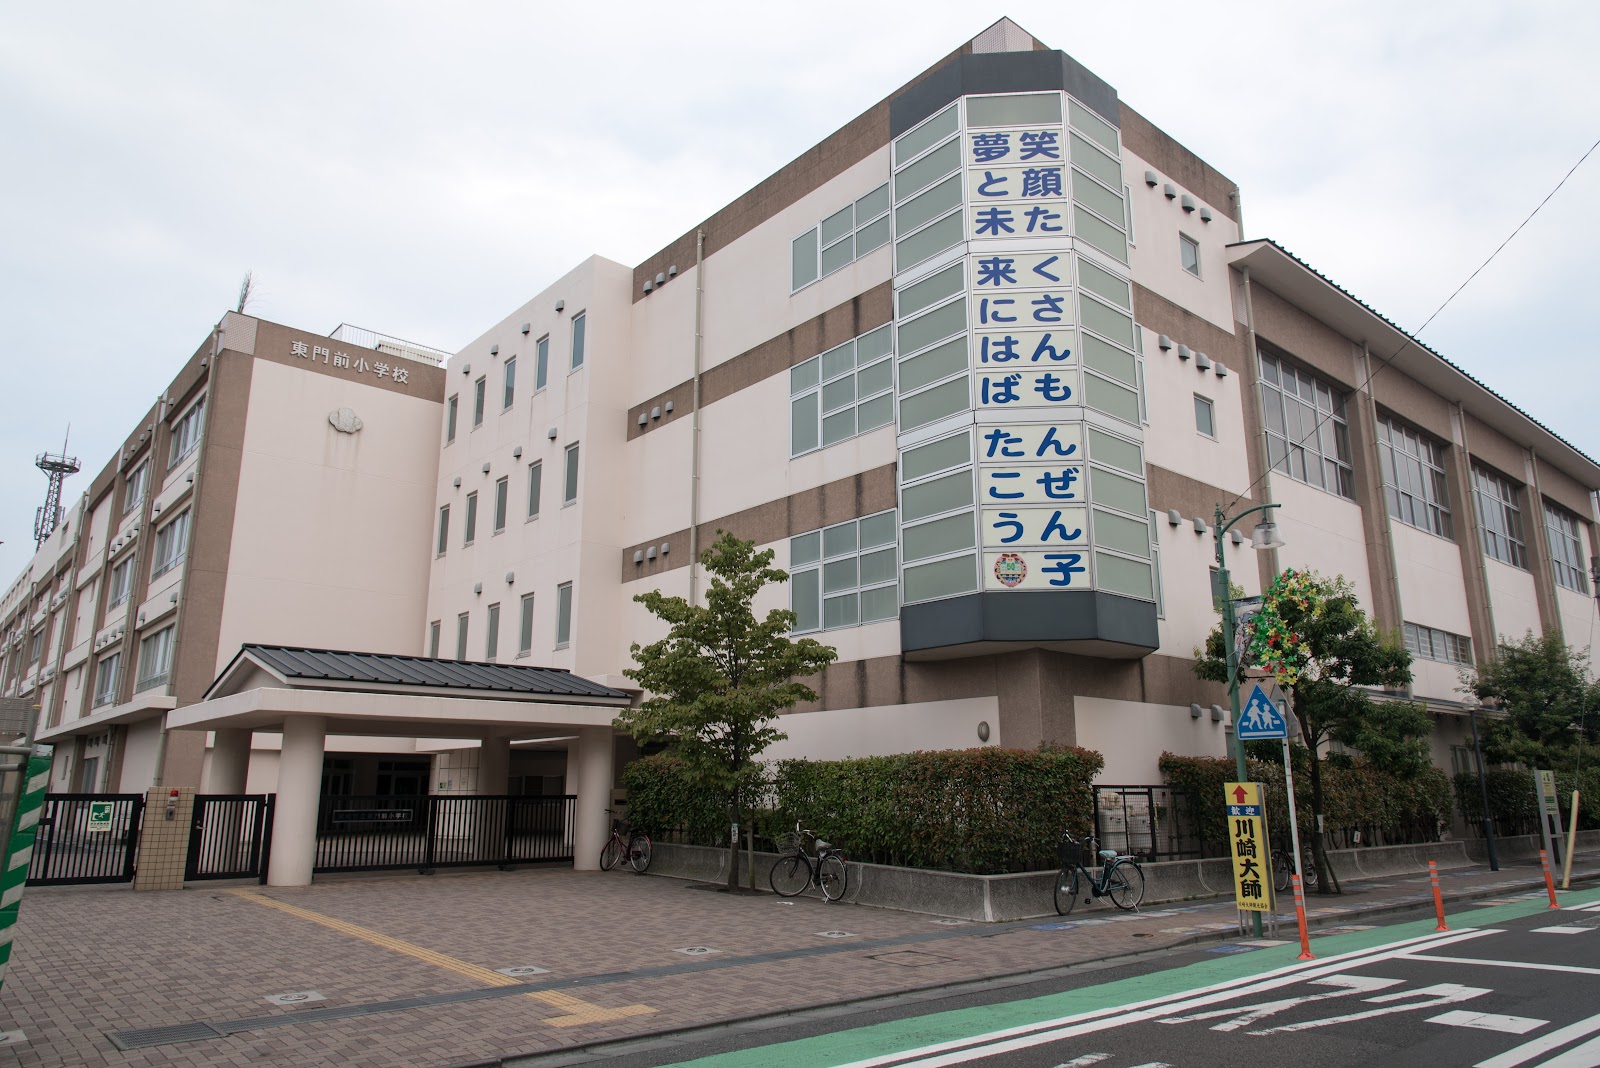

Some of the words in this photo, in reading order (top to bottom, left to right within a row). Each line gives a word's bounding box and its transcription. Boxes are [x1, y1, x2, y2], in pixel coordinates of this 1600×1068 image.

[290, 340, 409, 384] 東門前小学校
[971, 133, 1025, 544] 夢と未来にはばたこう
[1019, 131, 1086, 586] 笑顔たくさんもんぜん子
[1231, 805, 1255, 815] 歓迎
[1235, 818, 1262, 899] 川崎大師
